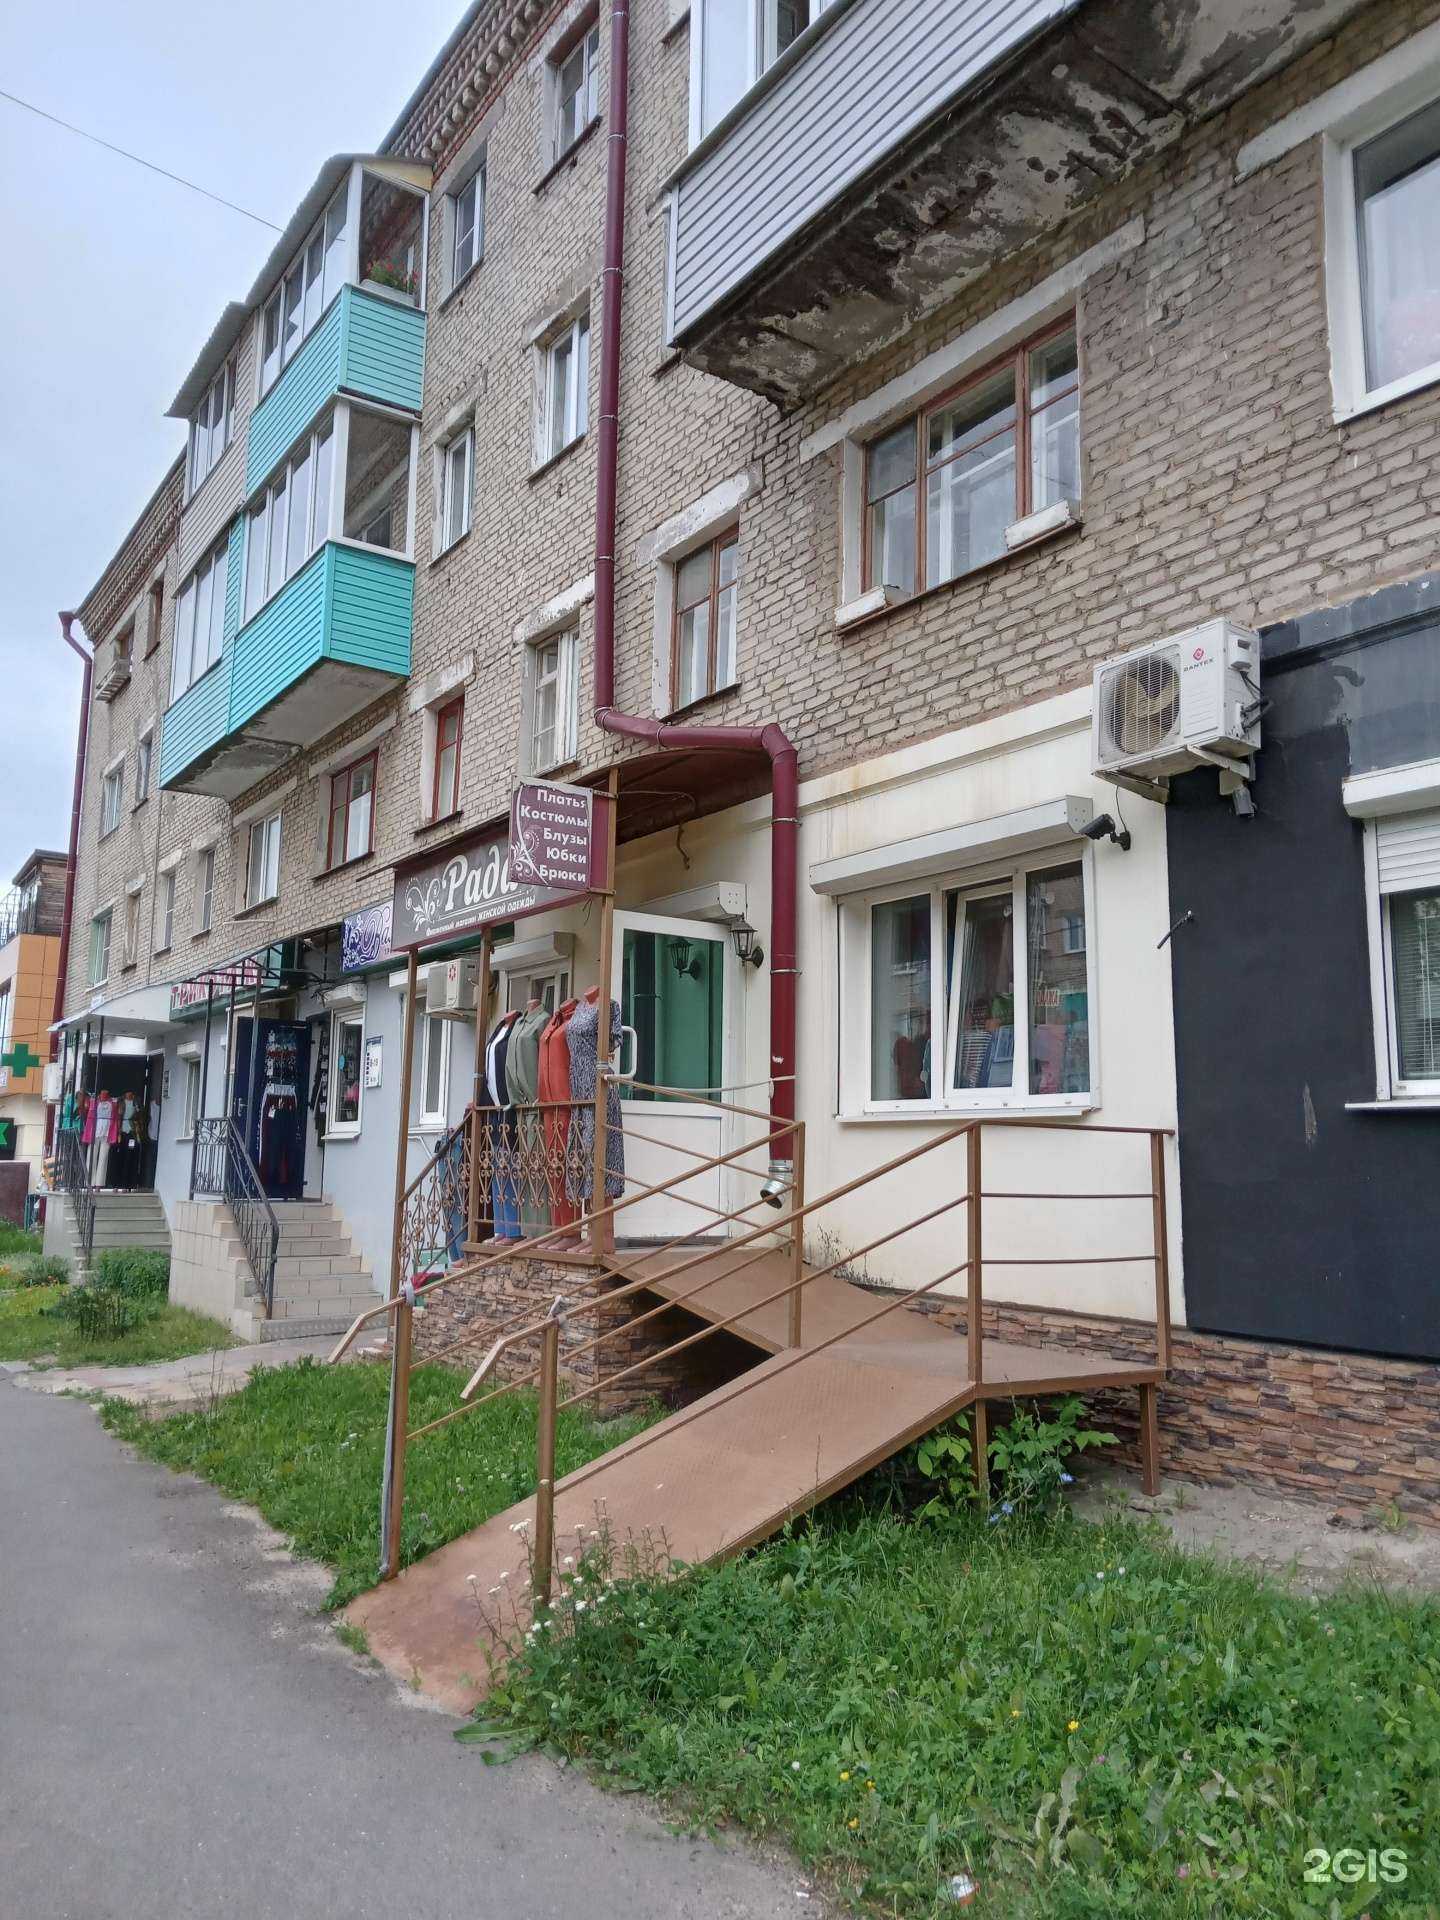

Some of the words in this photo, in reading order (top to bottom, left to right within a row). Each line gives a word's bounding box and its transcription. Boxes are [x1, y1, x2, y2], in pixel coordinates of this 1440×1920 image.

[537, 788, 586, 808] Платья
[520, 805, 588, 828] Костюмы
[543, 827, 587, 846] Блузы
[546, 846, 587, 864] Юбки
[540, 864, 586, 883] Брюки
[478, 902, 506, 922] ЖЕНСКОЙ
[507, 894, 536, 913] ОДЕЖДЫ
